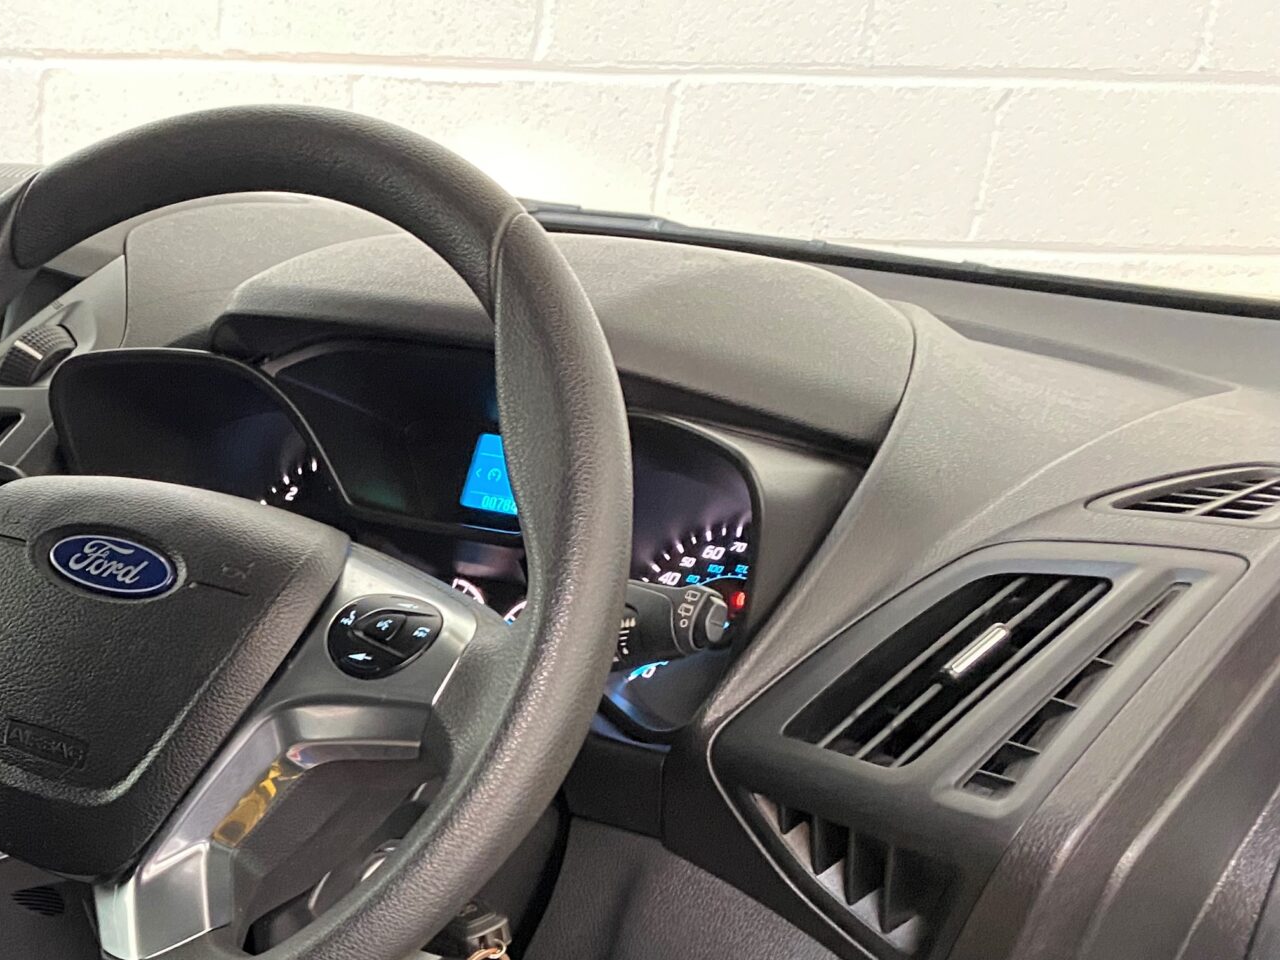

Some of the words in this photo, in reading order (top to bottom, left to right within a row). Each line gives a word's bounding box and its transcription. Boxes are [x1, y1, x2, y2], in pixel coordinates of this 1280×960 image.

[284, 486, 299, 501] 2
[68, 539, 149, 584] Ford
[657, 570, 682, 586] 40
[678, 556, 697, 568] 50
[701, 545, 726, 561] 60
[729, 541, 748, 553] 70
